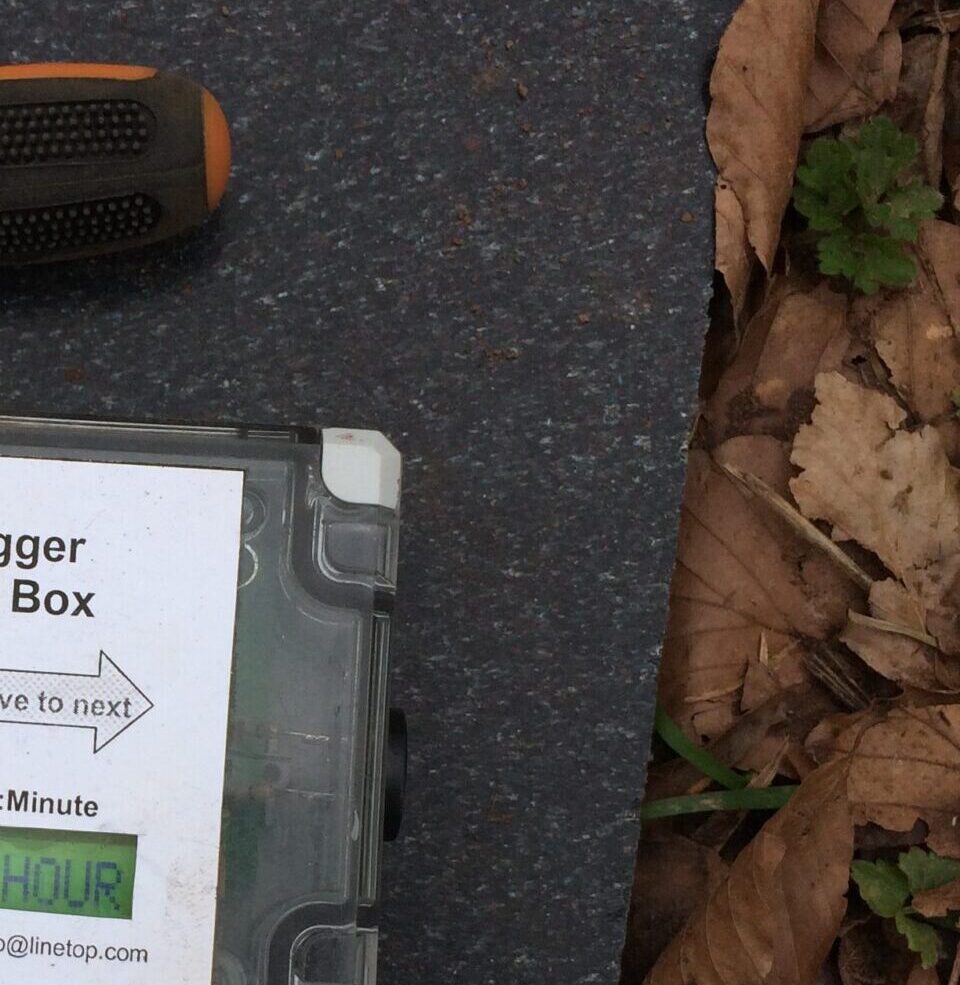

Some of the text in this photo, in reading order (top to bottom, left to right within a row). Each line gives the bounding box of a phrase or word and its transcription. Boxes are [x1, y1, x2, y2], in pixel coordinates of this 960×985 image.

[10, 577, 96, 619] Box
[37, 690, 65, 714] to
[72, 696, 133, 720] next
[0, 852, 124, 913] HOUR
